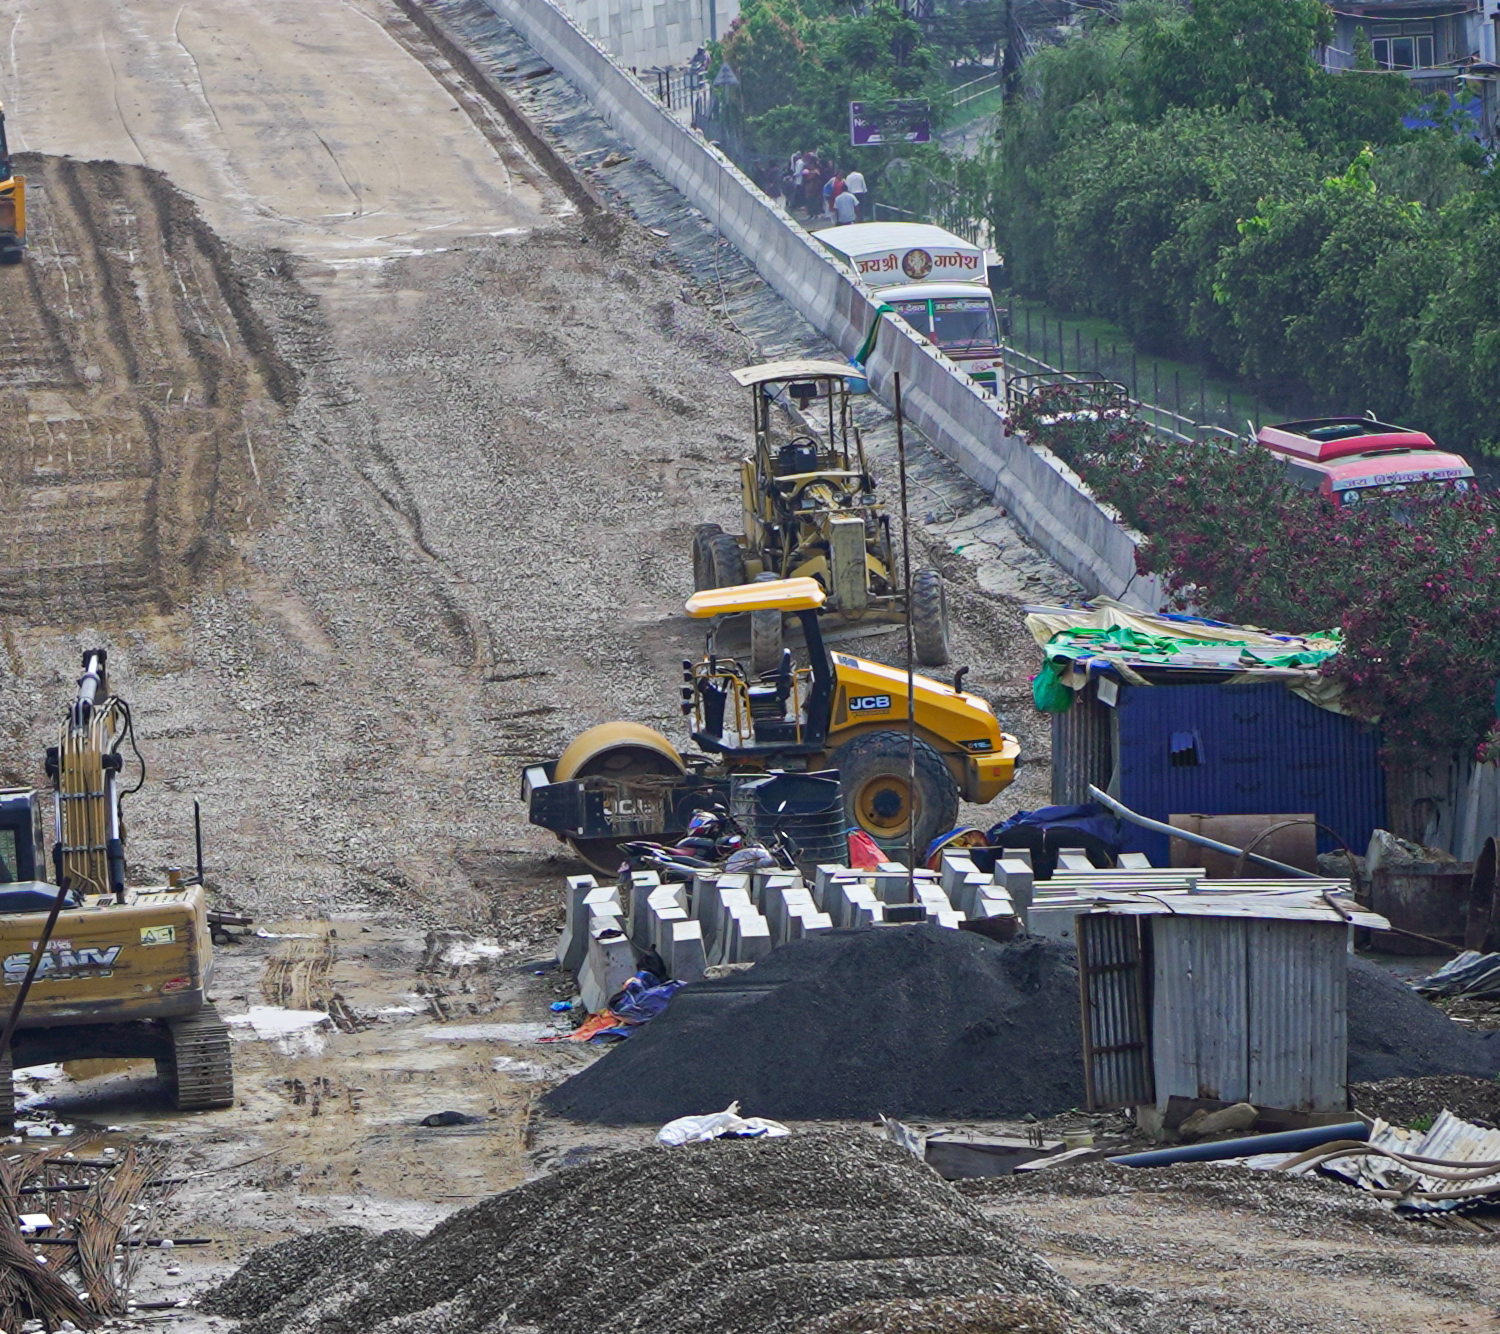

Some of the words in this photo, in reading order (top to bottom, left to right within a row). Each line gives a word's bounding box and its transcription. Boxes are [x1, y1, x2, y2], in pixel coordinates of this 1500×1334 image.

[857, 259, 881, 274] जय
[882, 253, 898, 272] श्री
[934, 251, 979, 269] गणेश
[850, 696, 890, 710] JCB
[2, 946, 122, 983] SANY
